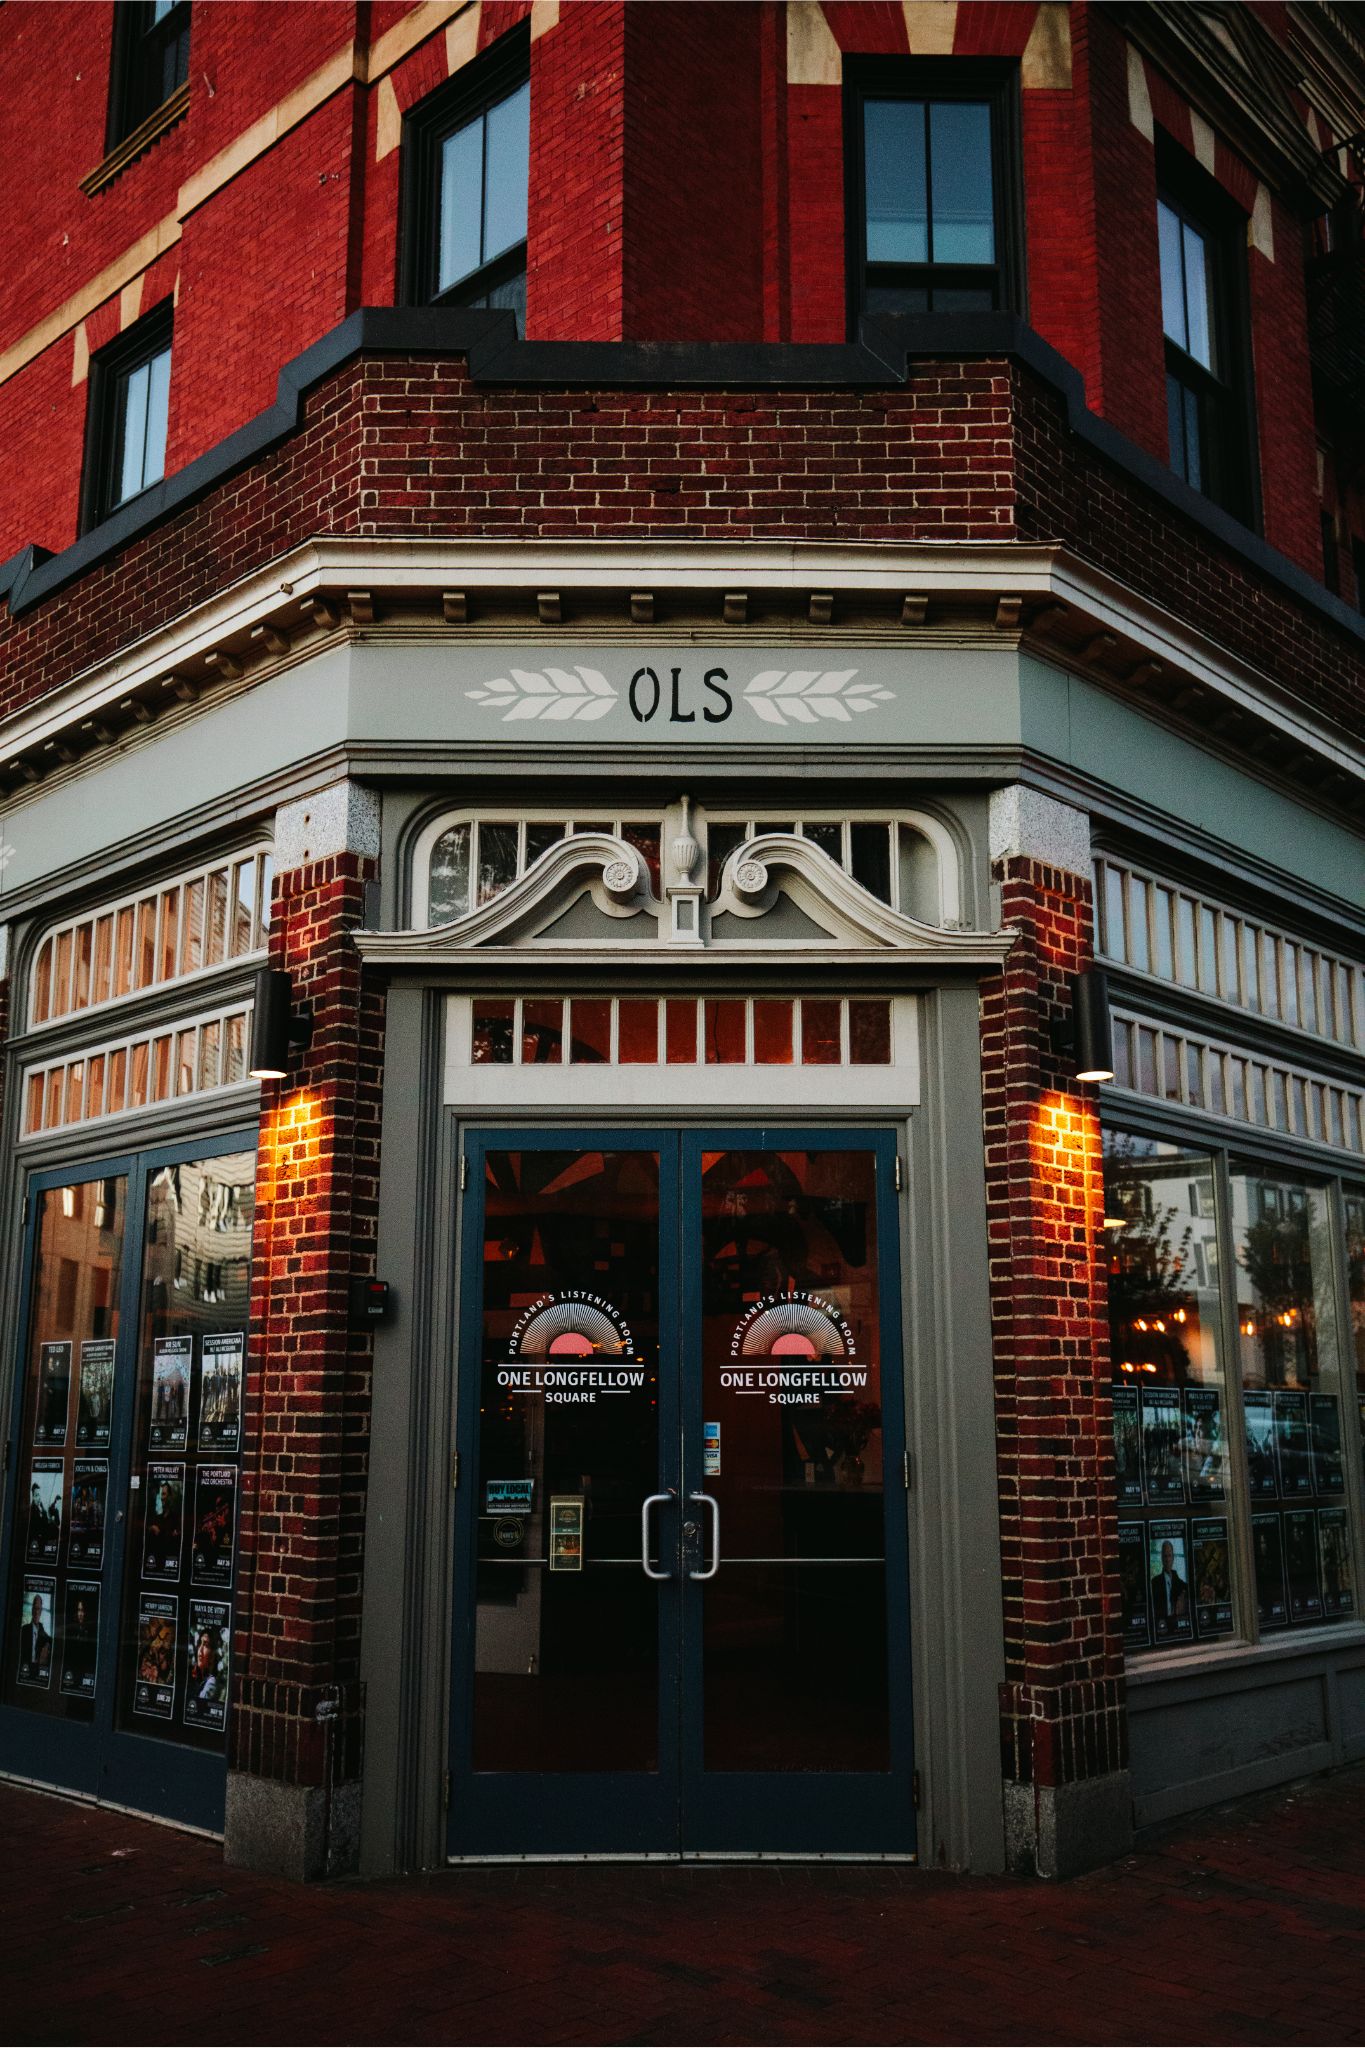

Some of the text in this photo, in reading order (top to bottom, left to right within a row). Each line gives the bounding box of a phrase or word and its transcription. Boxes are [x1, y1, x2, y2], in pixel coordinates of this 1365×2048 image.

[628, 667, 733, 724] OLS
[508, 1290, 635, 1356] PORTLAND'S LISTENING ROOM
[730, 1291, 857, 1357] PORTLAND'S LISTENING ROOM
[496, 1371, 645, 1387] ONE LONGFELLOW
[719, 1372, 868, 1387] ONE LONGFELLOW
[545, 1392, 597, 1404] SQUARE
[768, 1393, 821, 1405] SQUARE
